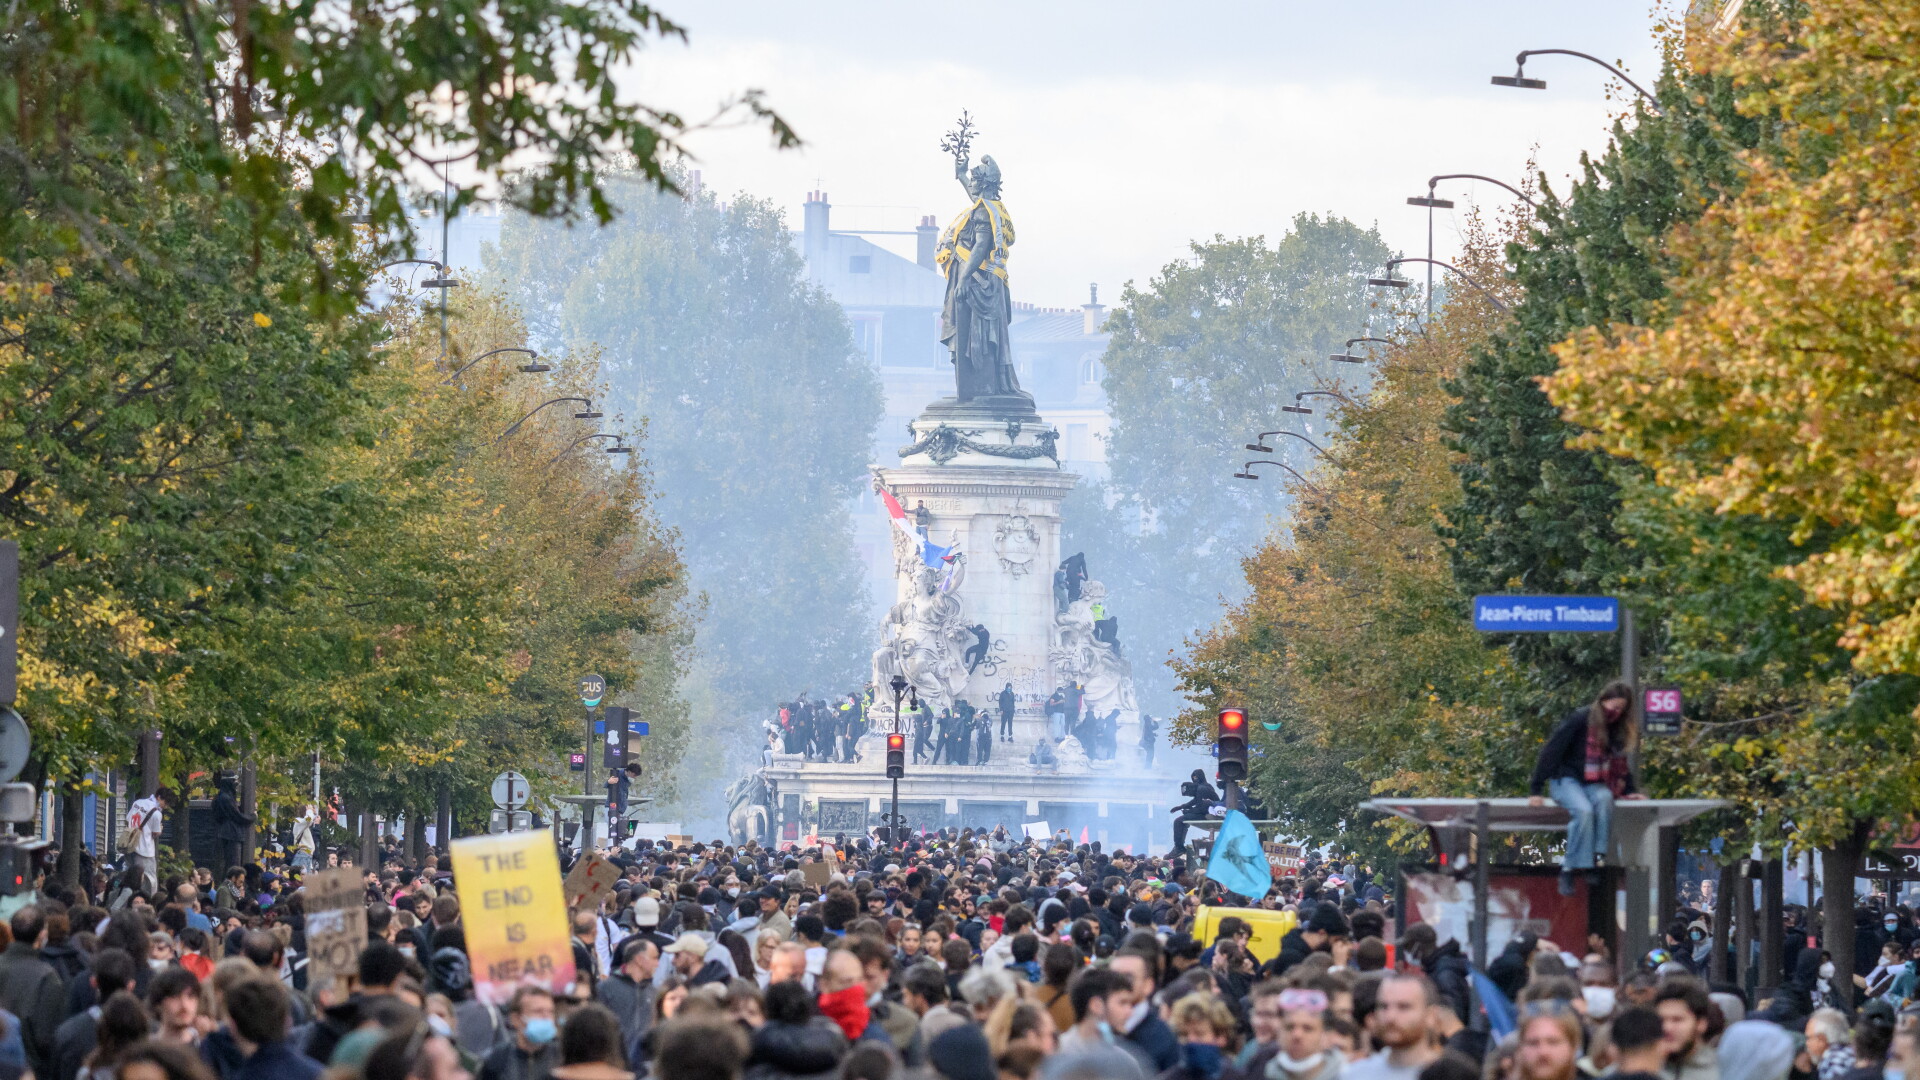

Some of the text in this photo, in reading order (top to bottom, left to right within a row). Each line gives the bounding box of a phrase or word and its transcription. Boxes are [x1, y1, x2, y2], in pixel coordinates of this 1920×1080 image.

[1479, 605, 1613, 622] Jean-Pierre Timbaud
[1650, 692, 1676, 711] 56
[572, 755, 584, 763] 56
[476, 851, 527, 873] THE
[1865, 856, 1891, 872] LE
[483, 885, 533, 910] END
[506, 922, 527, 942] IS
[488, 954, 554, 980] NEAR
